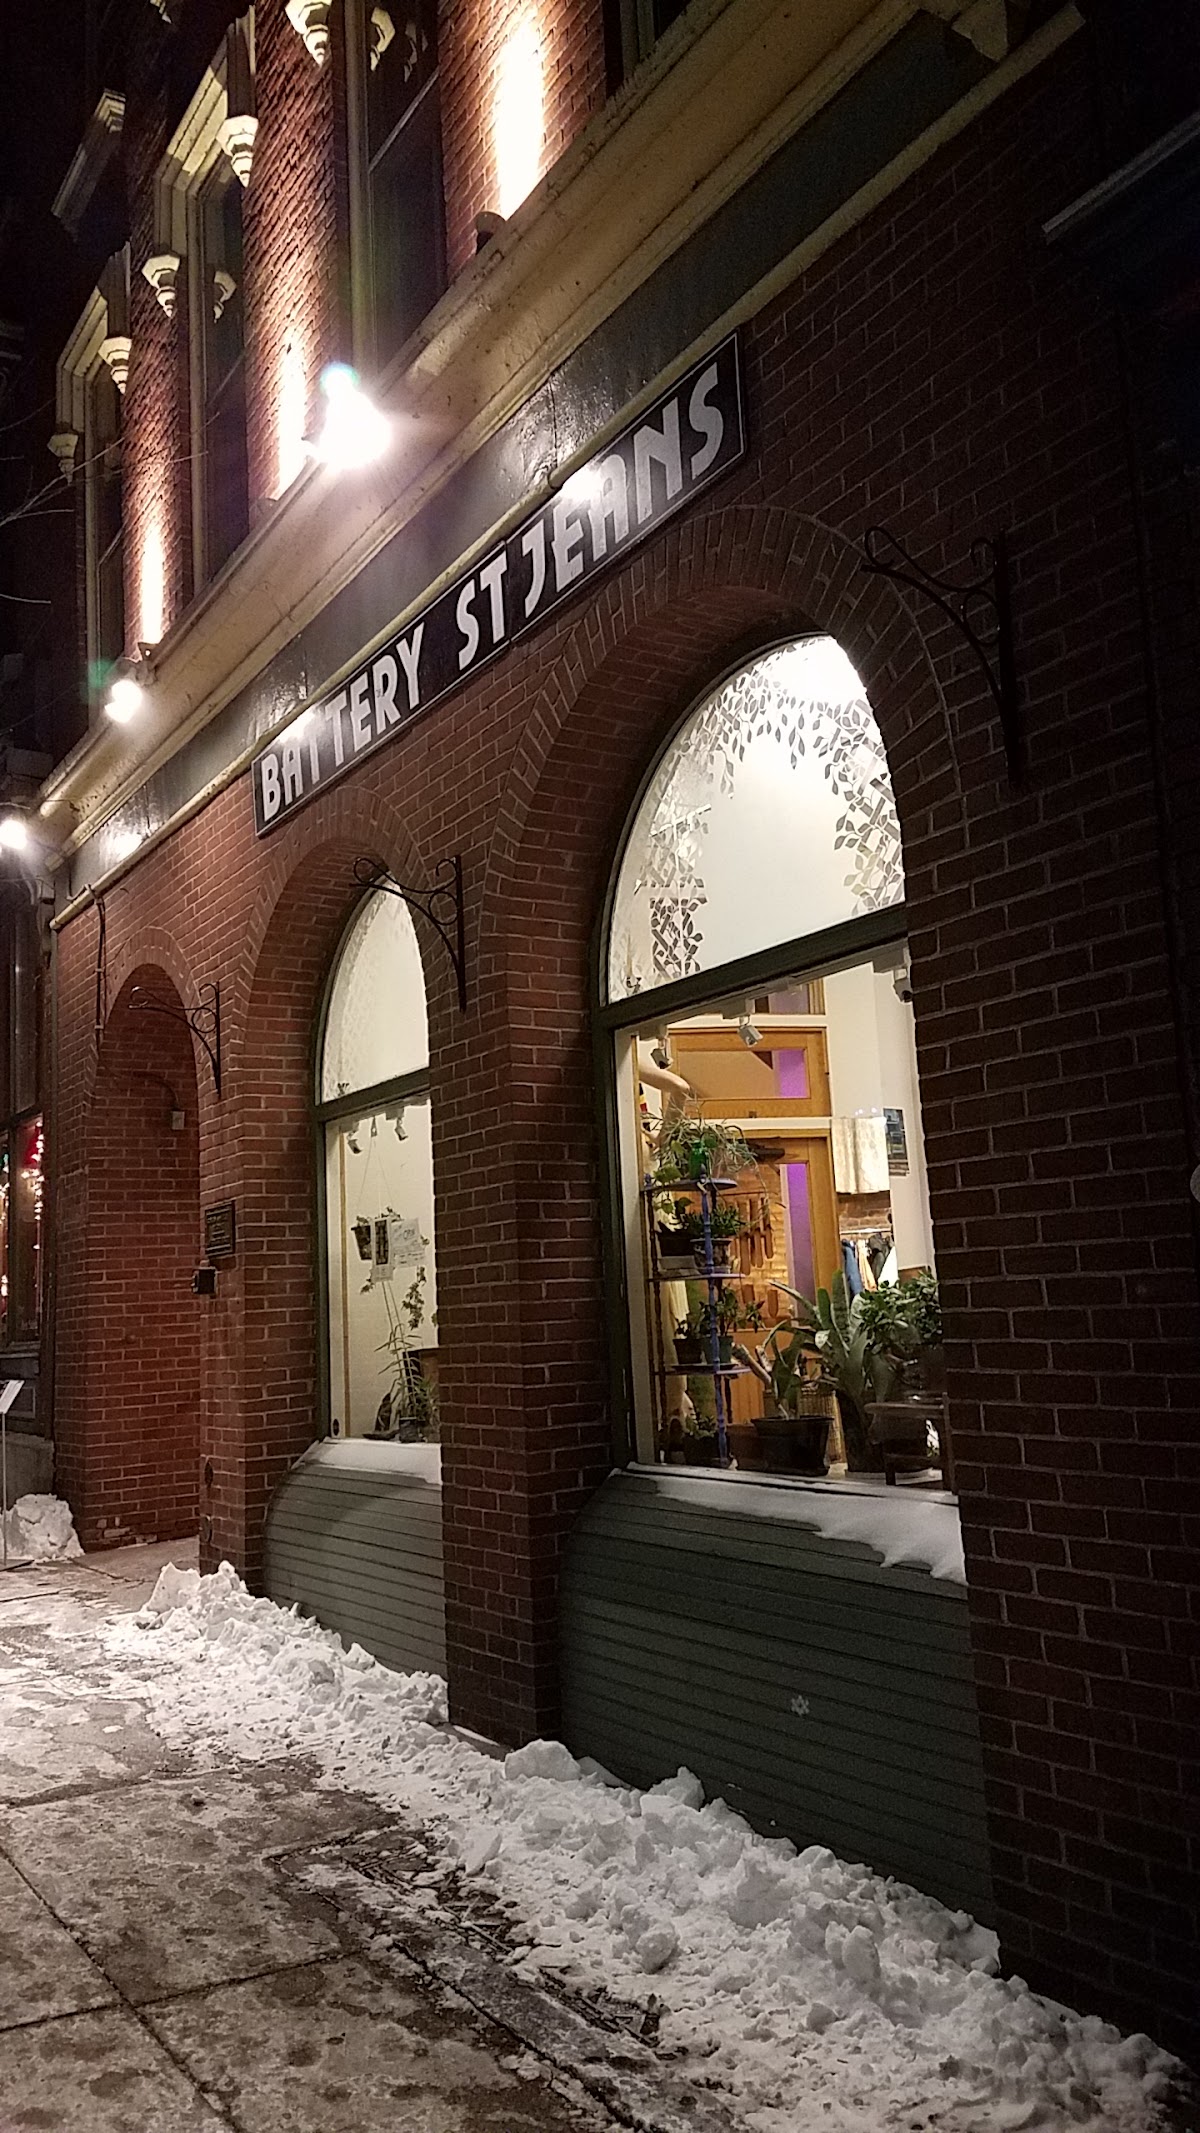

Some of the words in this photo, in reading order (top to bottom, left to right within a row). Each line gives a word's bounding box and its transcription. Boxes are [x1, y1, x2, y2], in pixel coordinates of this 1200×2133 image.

[261, 622, 424, 822] BATTERY
[456, 551, 508, 671] ST
[522, 362, 724, 618] JEANS
